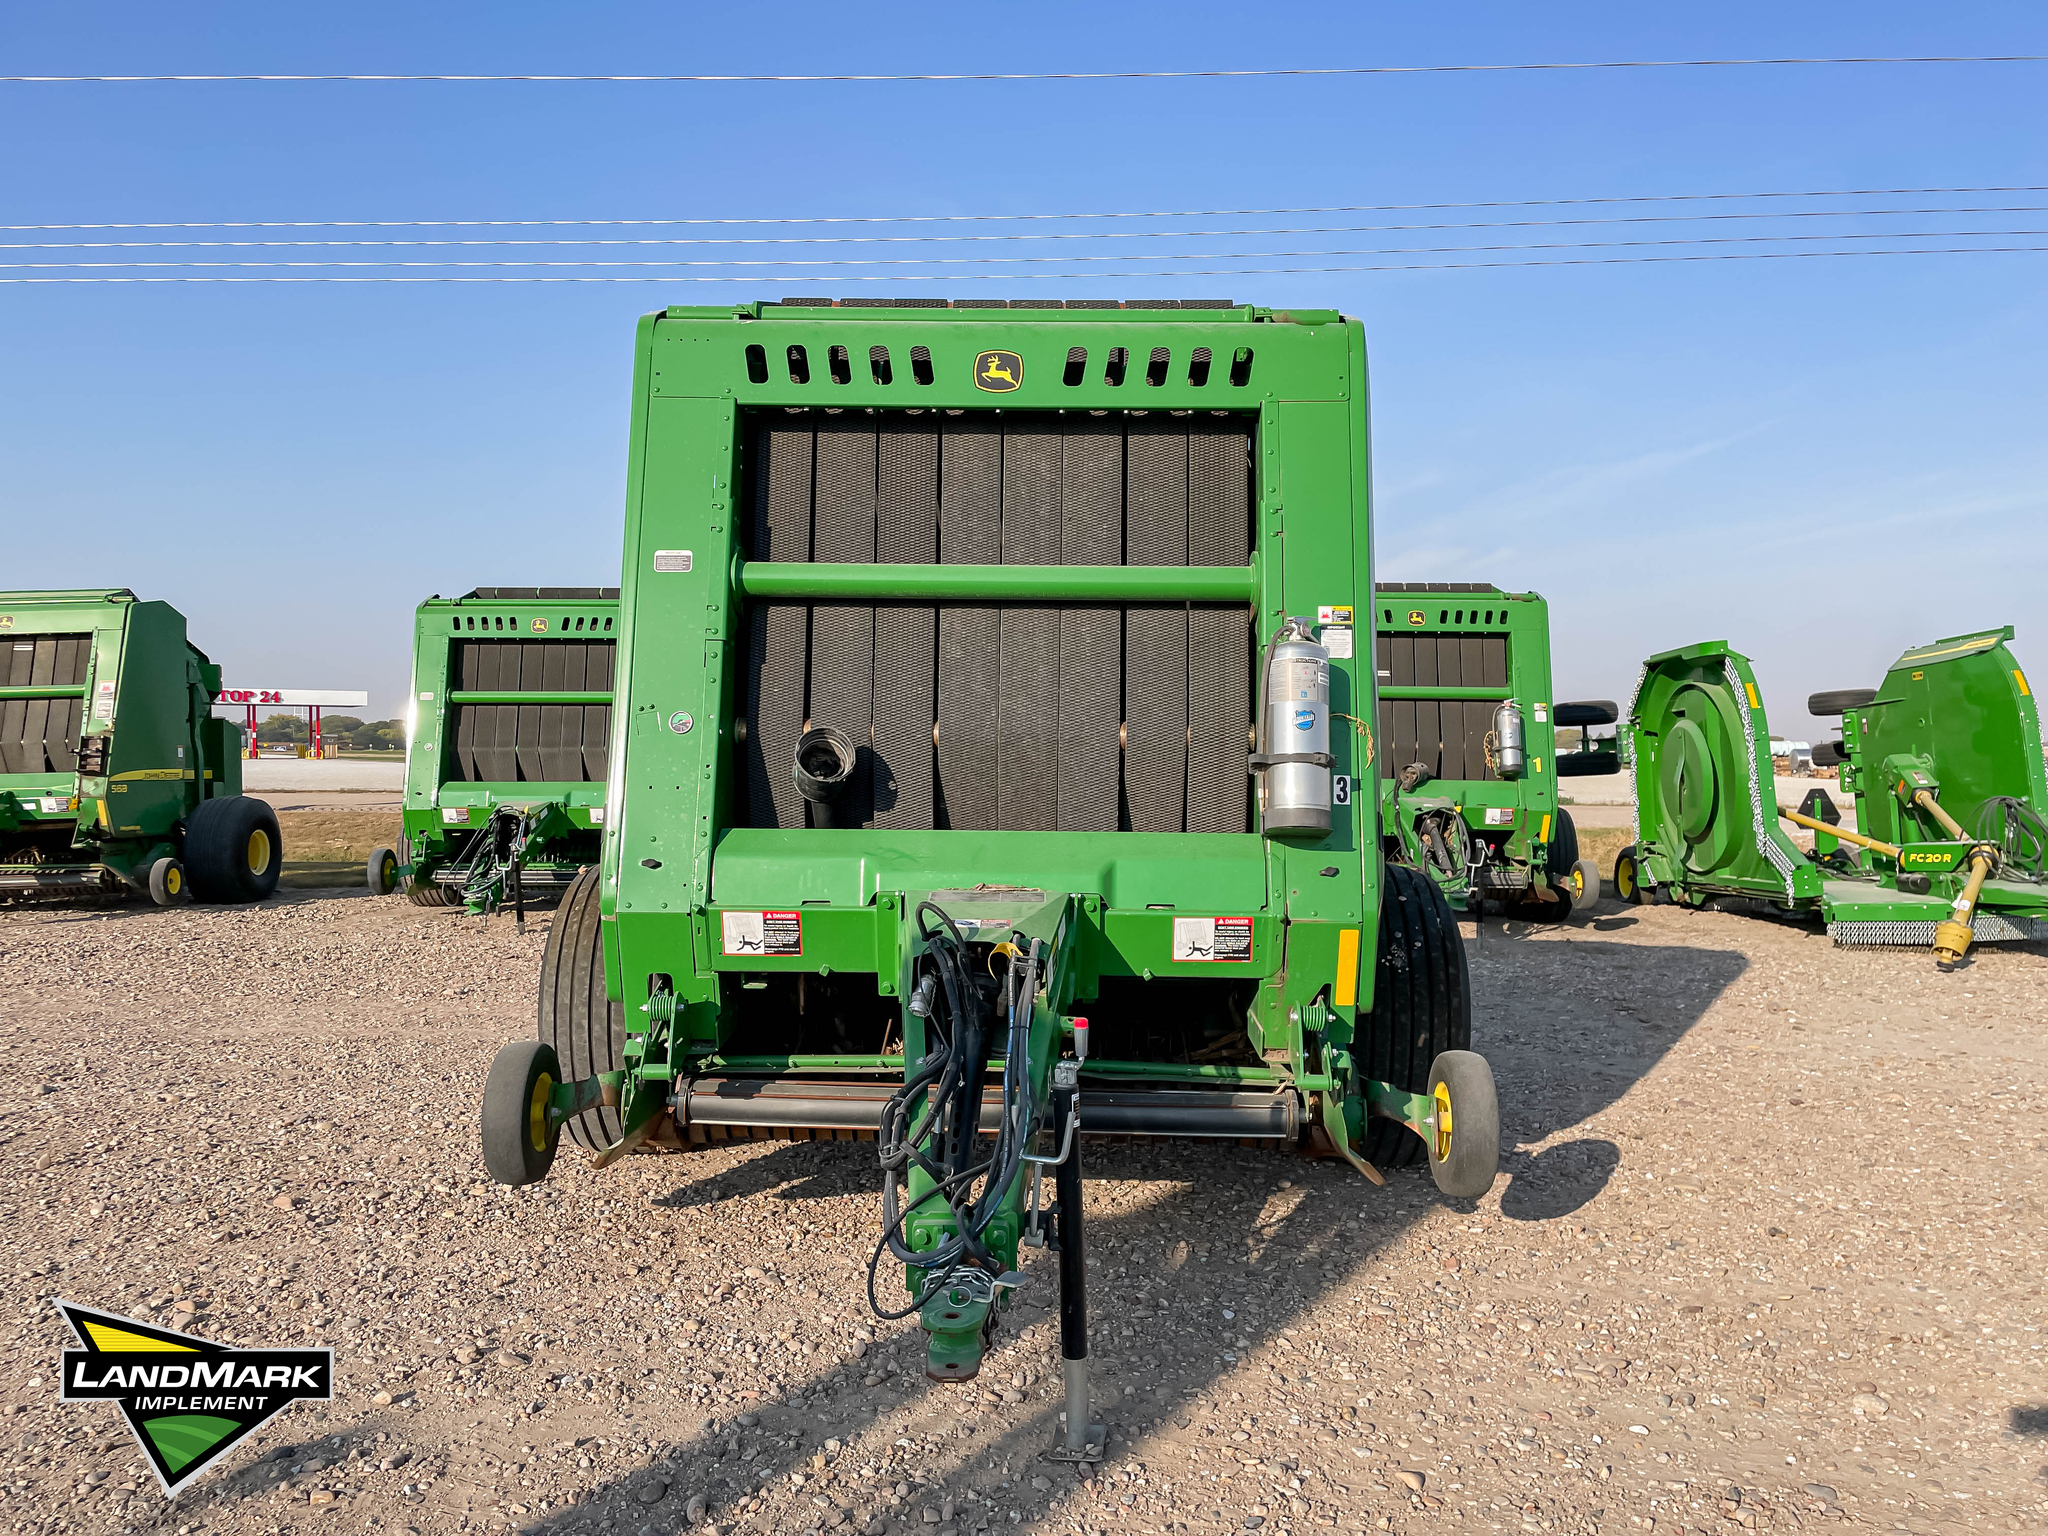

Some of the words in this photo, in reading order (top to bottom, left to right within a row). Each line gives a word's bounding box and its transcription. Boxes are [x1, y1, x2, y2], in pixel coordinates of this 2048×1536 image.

[217, 690, 256, 703] TOP
[260, 690, 282, 703] 24
[1532, 757, 1542, 773] 1
[1336, 776, 1348, 804] 3
